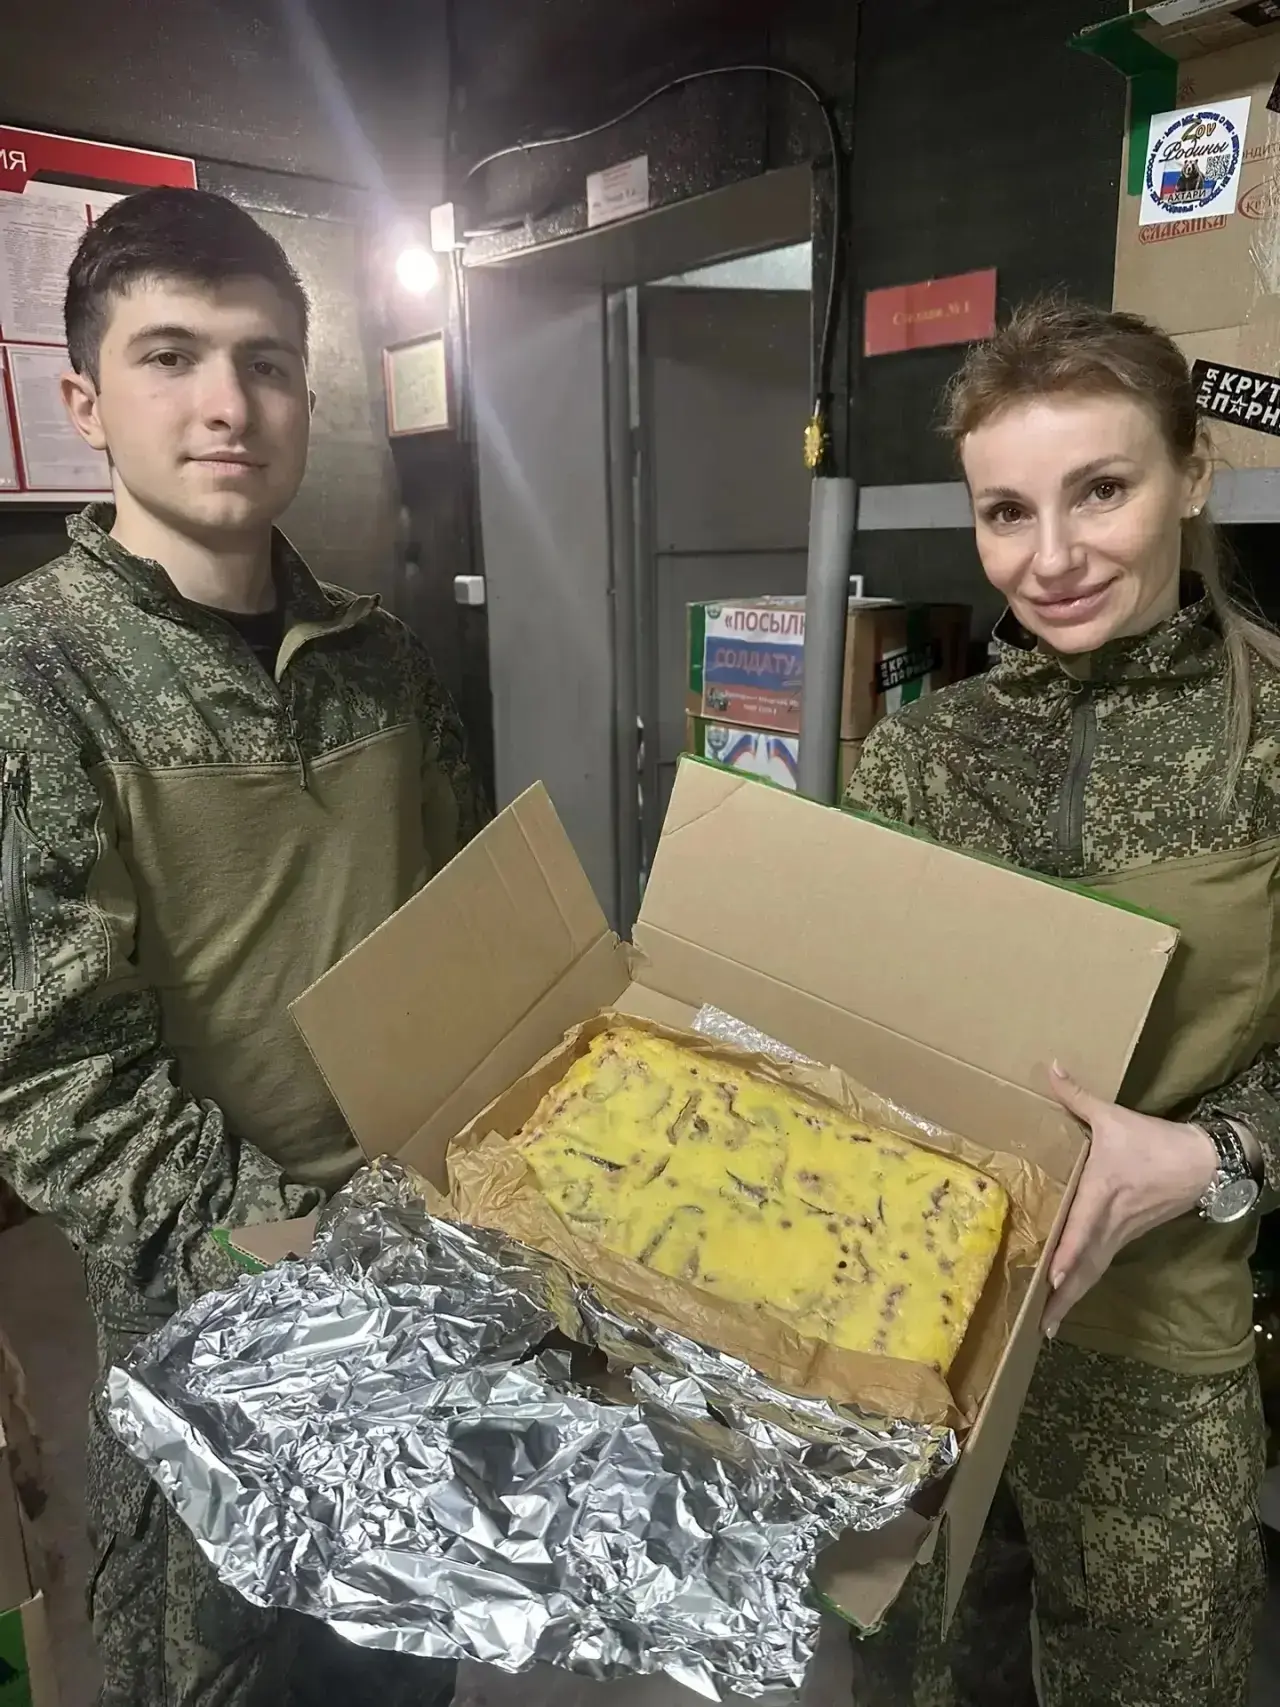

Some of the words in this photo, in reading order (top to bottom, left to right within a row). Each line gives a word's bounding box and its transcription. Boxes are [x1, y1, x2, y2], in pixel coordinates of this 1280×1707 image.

[1158, 139, 1229, 163] Родины
[1243, 143, 1280, 159] НДИТ
[1167, 189, 1207, 203] АХТАРИ
[1196, 368, 1220, 409] ДЛЯ
[1219, 372, 1280, 403] КРУТ
